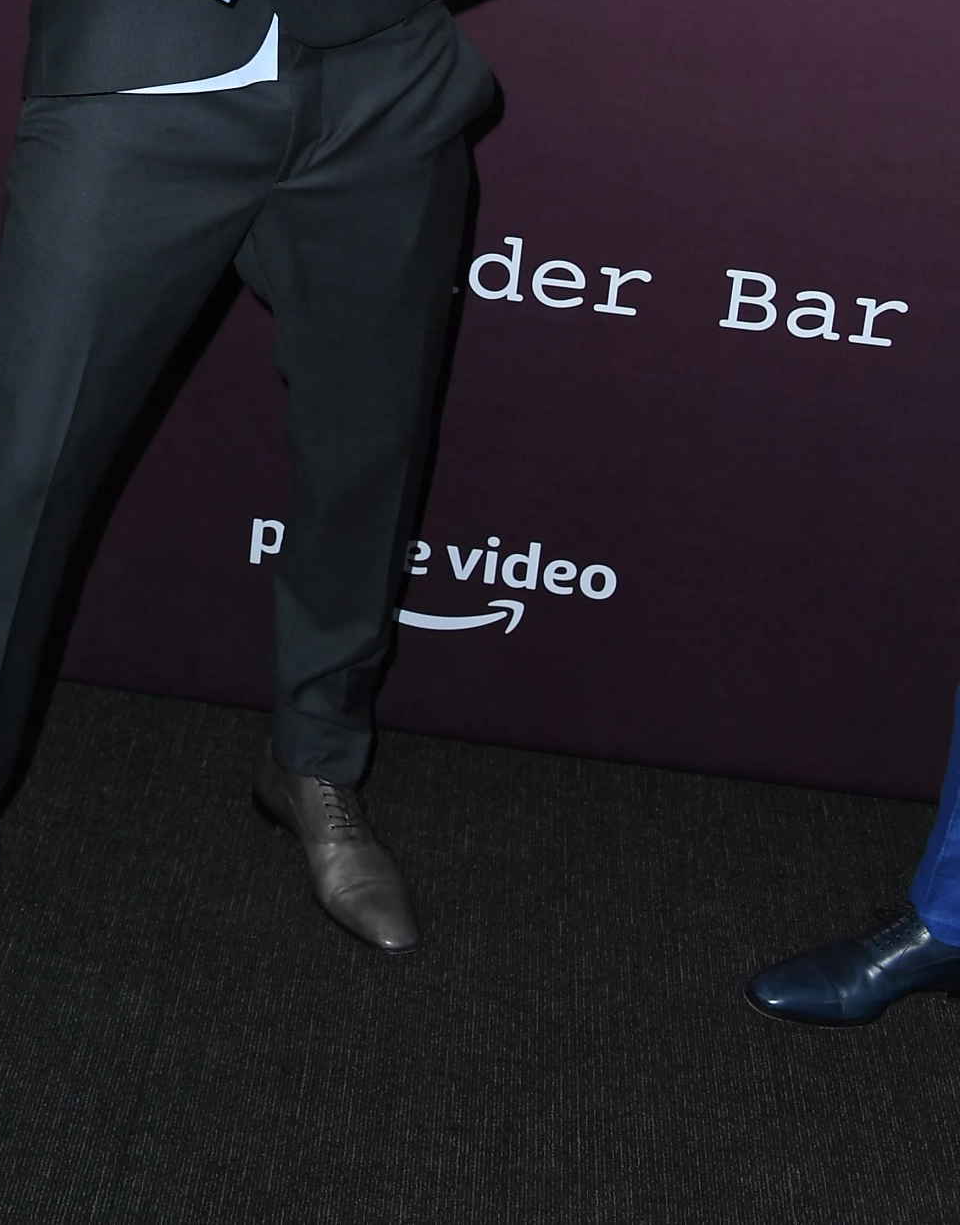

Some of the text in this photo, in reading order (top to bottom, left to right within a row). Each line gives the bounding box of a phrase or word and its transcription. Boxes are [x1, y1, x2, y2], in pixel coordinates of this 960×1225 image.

[452, 236, 909, 347] der Bar
[446, 536, 618, 600] video
